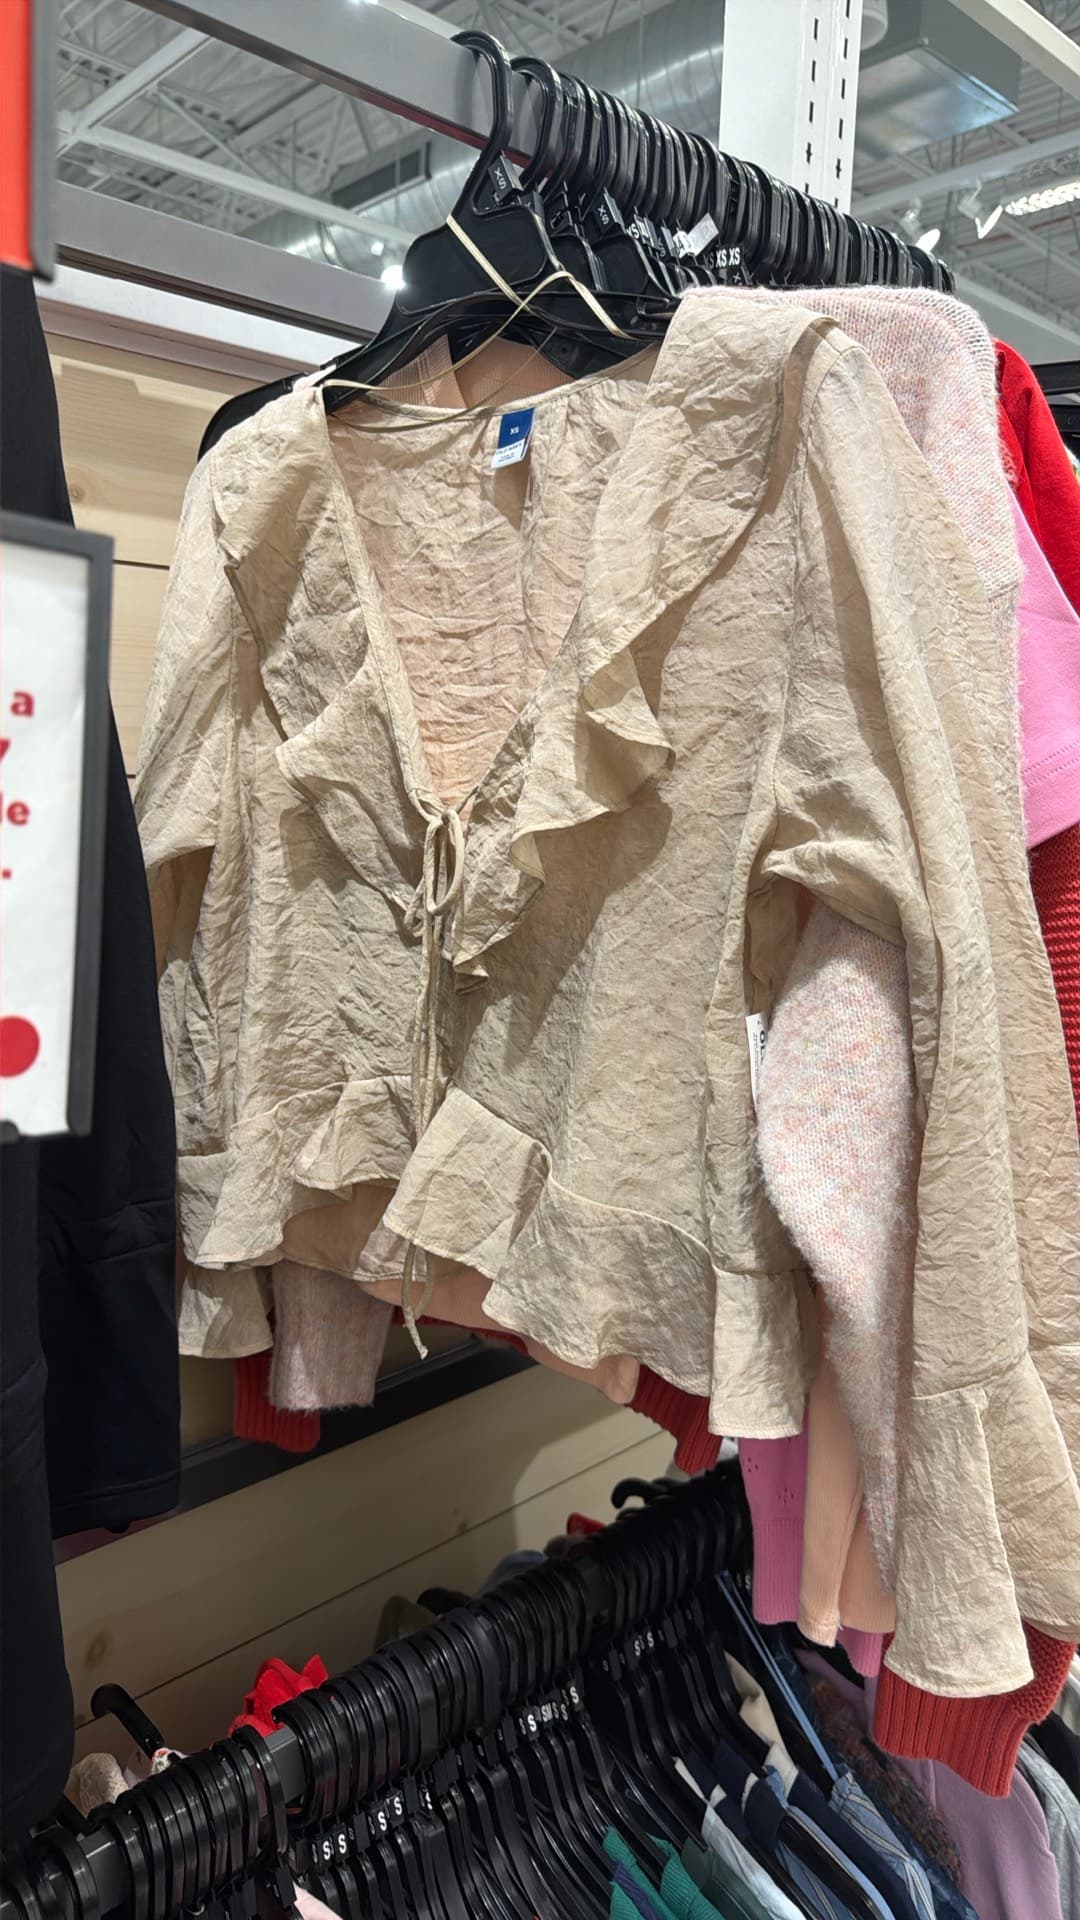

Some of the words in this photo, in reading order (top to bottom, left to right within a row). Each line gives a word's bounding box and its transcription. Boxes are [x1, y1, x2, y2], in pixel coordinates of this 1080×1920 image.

[494, 167, 507, 190] XS
[597, 204, 610, 225] XS
[715, 248, 727, 269] XS
[728, 247, 741, 267] XS
[10, 691, 34, 717] a
[570, 1686, 579, 1704] S
[527, 1714, 537, 1732] S
[393, 1796, 403, 1816] S
[377, 1811, 388, 1832] S
[322, 1840, 331, 1861] S
[337, 1833, 347, 1855] S
